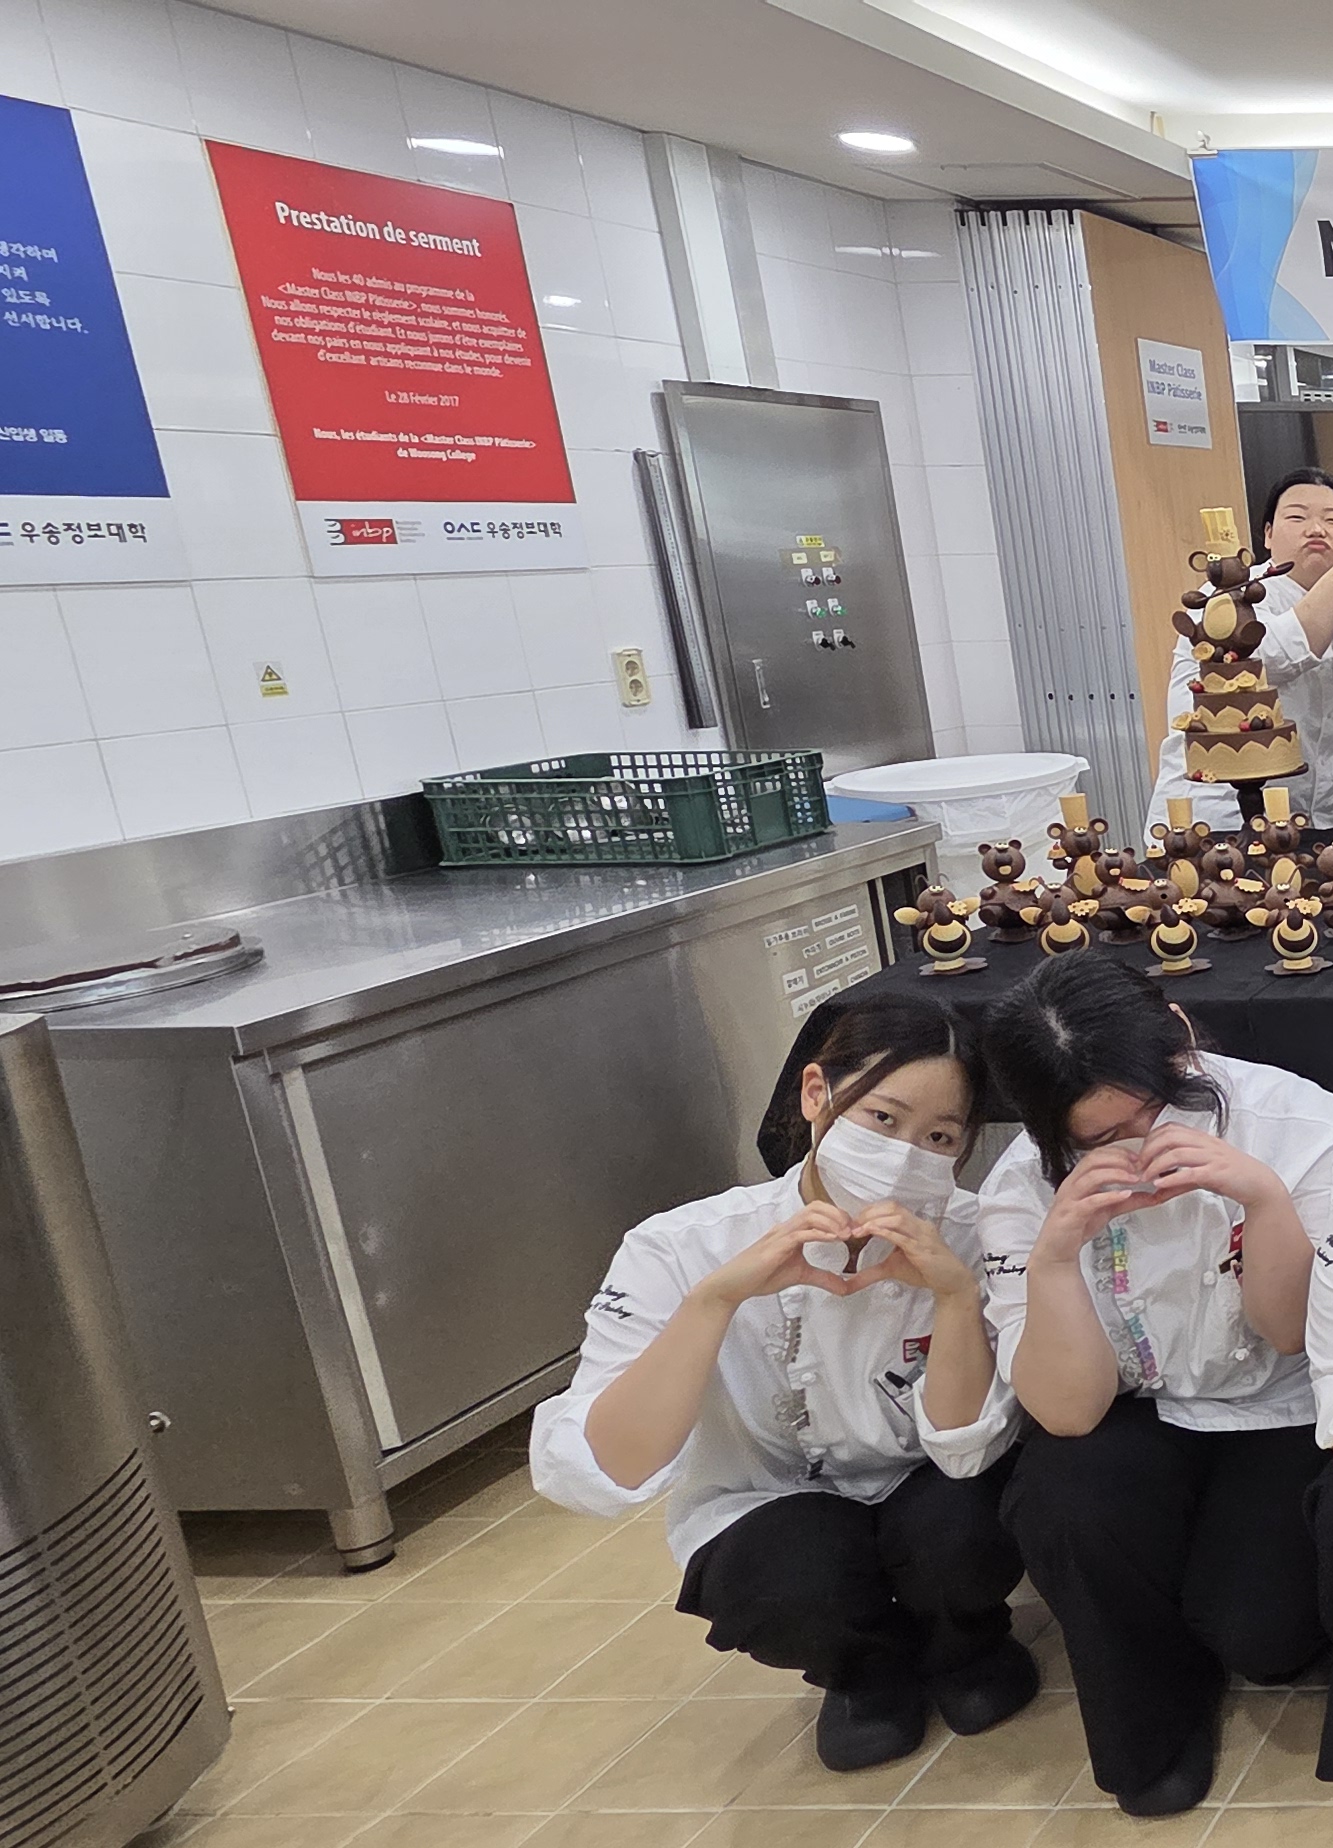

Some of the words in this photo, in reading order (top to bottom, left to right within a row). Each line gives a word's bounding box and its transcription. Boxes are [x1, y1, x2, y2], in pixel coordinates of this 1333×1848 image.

[275, 201, 380, 240] Prestation
[383, 220, 406, 245] de
[409, 230, 482, 258] serment
[311, 267, 337, 283] Nous
[3, 310, 90, 334] 선서합니다.
[1148, 358, 1175, 377] Master
[1176, 363, 1196, 380] Class
[1167, 382, 1203, 401] Pâtisserie
[20, 521, 147, 546] 우송정보대학
[350, 521, 393, 542] inbp
[486, 521, 563, 539] 우송정보대학
